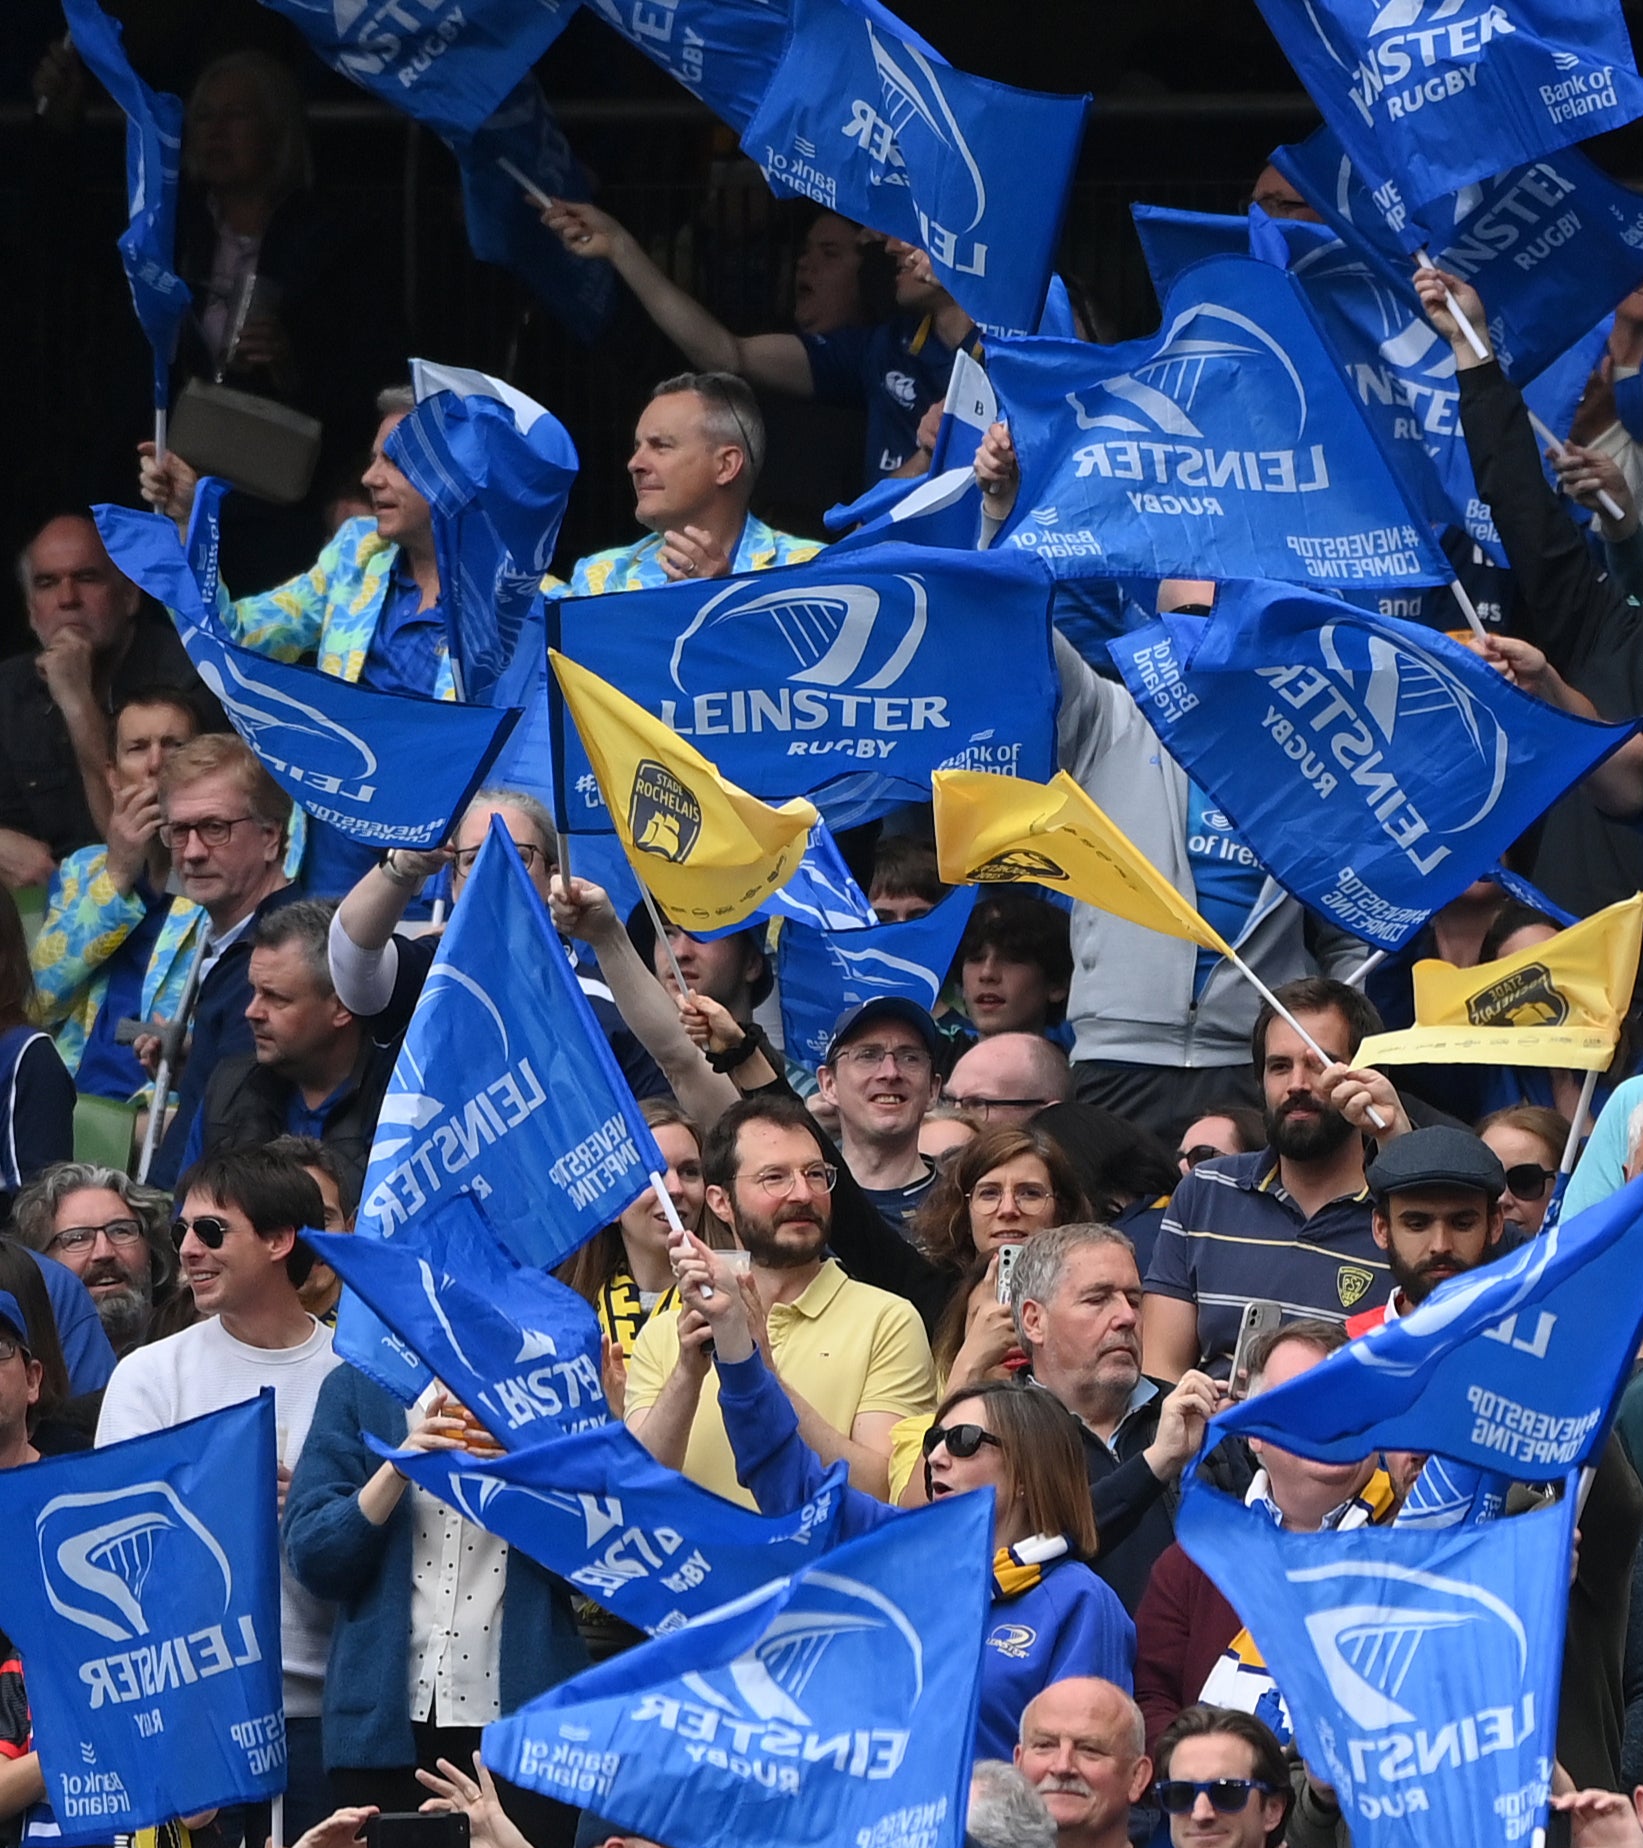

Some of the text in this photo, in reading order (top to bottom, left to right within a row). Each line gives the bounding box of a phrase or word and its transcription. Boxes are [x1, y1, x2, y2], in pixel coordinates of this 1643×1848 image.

[398, 6, 467, 89] RUGBY
[1386, 63, 1477, 122] RUGBY
[1539, 66, 1614, 106] Bank of
[1548, 88, 1618, 125] Ireland
[1513, 210, 1583, 272] RUGBY
[660, 687, 950, 736] LEINSTER
[787, 738, 897, 763] RUGBY
[996, 742, 1023, 762] of
[635, 778, 700, 823] ROCHELAIS
[657, 773, 683, 795] STADE
[1189, 835, 1217, 856] of
